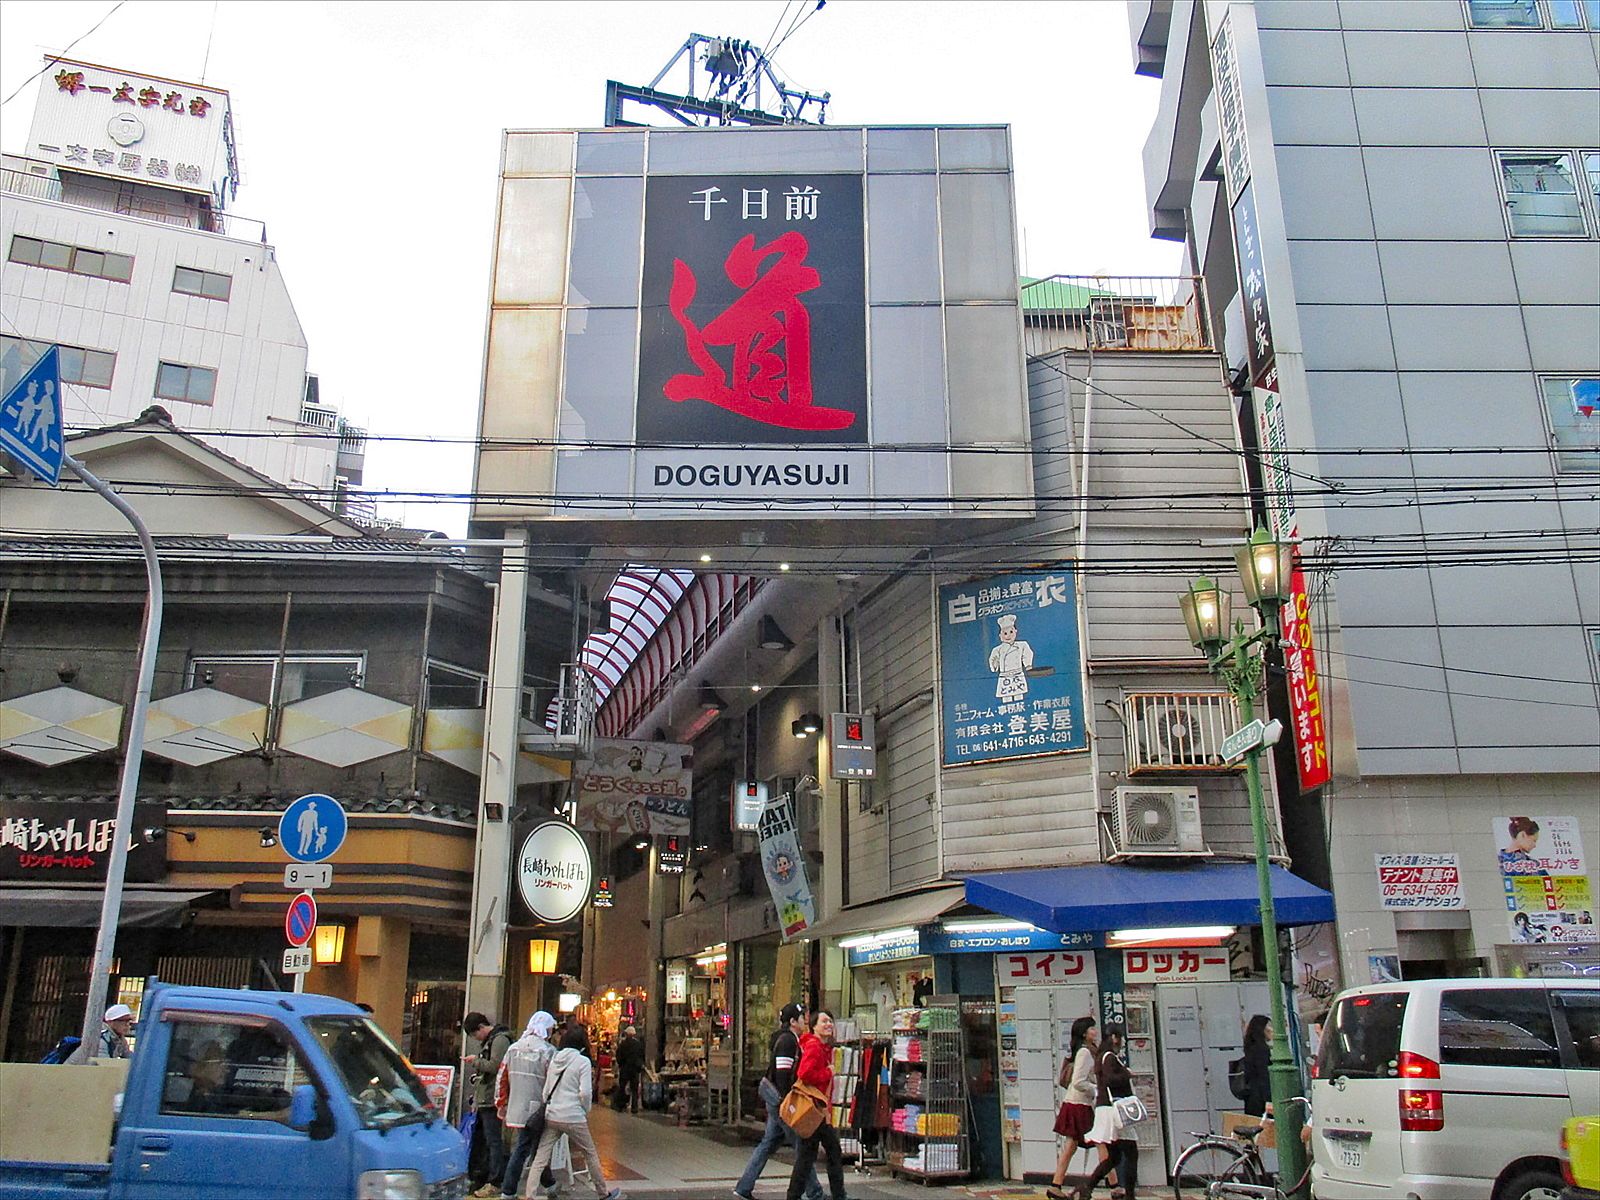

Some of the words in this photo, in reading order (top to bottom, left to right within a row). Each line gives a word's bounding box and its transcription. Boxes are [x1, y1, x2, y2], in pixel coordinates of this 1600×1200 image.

[688, 186, 821, 221] 千日前
[1246, 267, 1269, 360] 松乃家
[662, 231, 856, 430] 道
[654, 464, 849, 486] DOGUYASUJI
[948, 593, 977, 624] 白
[1035, 575, 1067, 608] 衣
[978, 580, 1034, 604] 品揃え豊富
[956, 744, 972, 755] TEL
[18, 854, 96, 869] リンガーハット
[523, 857, 586, 881] 長崎ちゃんぽん
[534, 878, 573, 892] リンガーハット
[1381, 868, 1456, 883] テナント募集中
[1383, 884, 1459, 896] 06-6341-5871
[1384, 896, 1461, 908] 株式会社アサショウ
[1060, 932, 1093, 945] とみや
[1009, 953, 1085, 977] コイン
[1126, 950, 1227, 974] ロッカー
